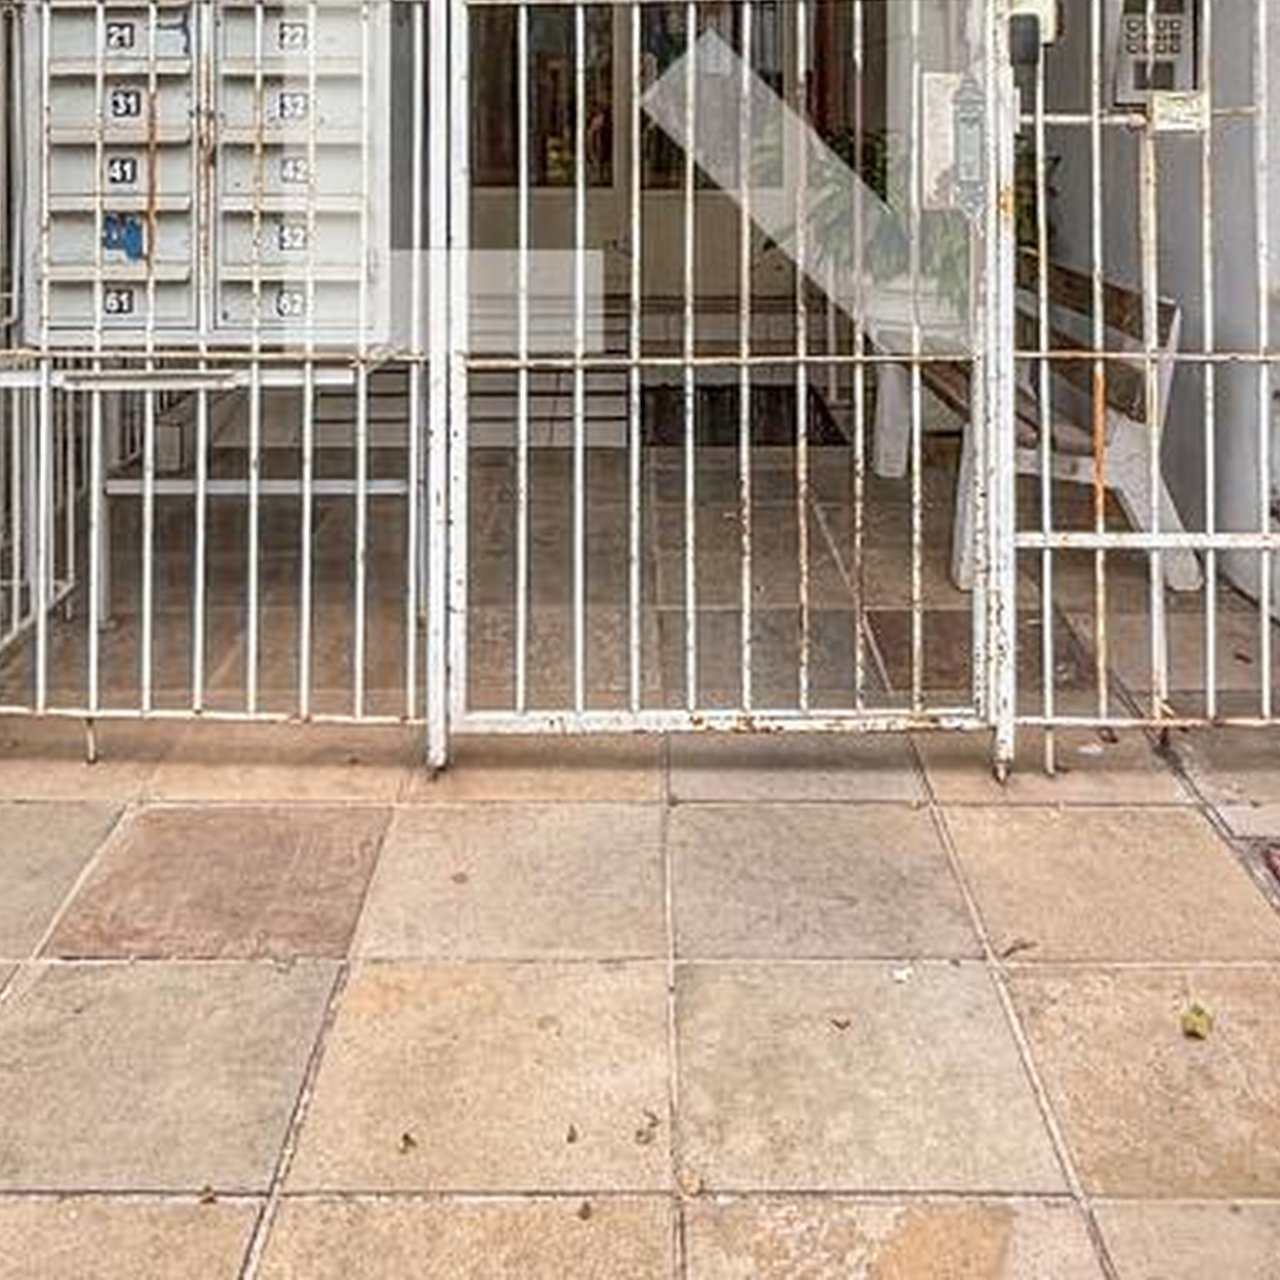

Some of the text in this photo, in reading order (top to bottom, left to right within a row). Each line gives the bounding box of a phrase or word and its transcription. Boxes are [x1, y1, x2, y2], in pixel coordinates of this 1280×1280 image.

[108, 25, 133, 48] 21
[113, 92, 138, 115] 31
[109, 159, 134, 181] 41
